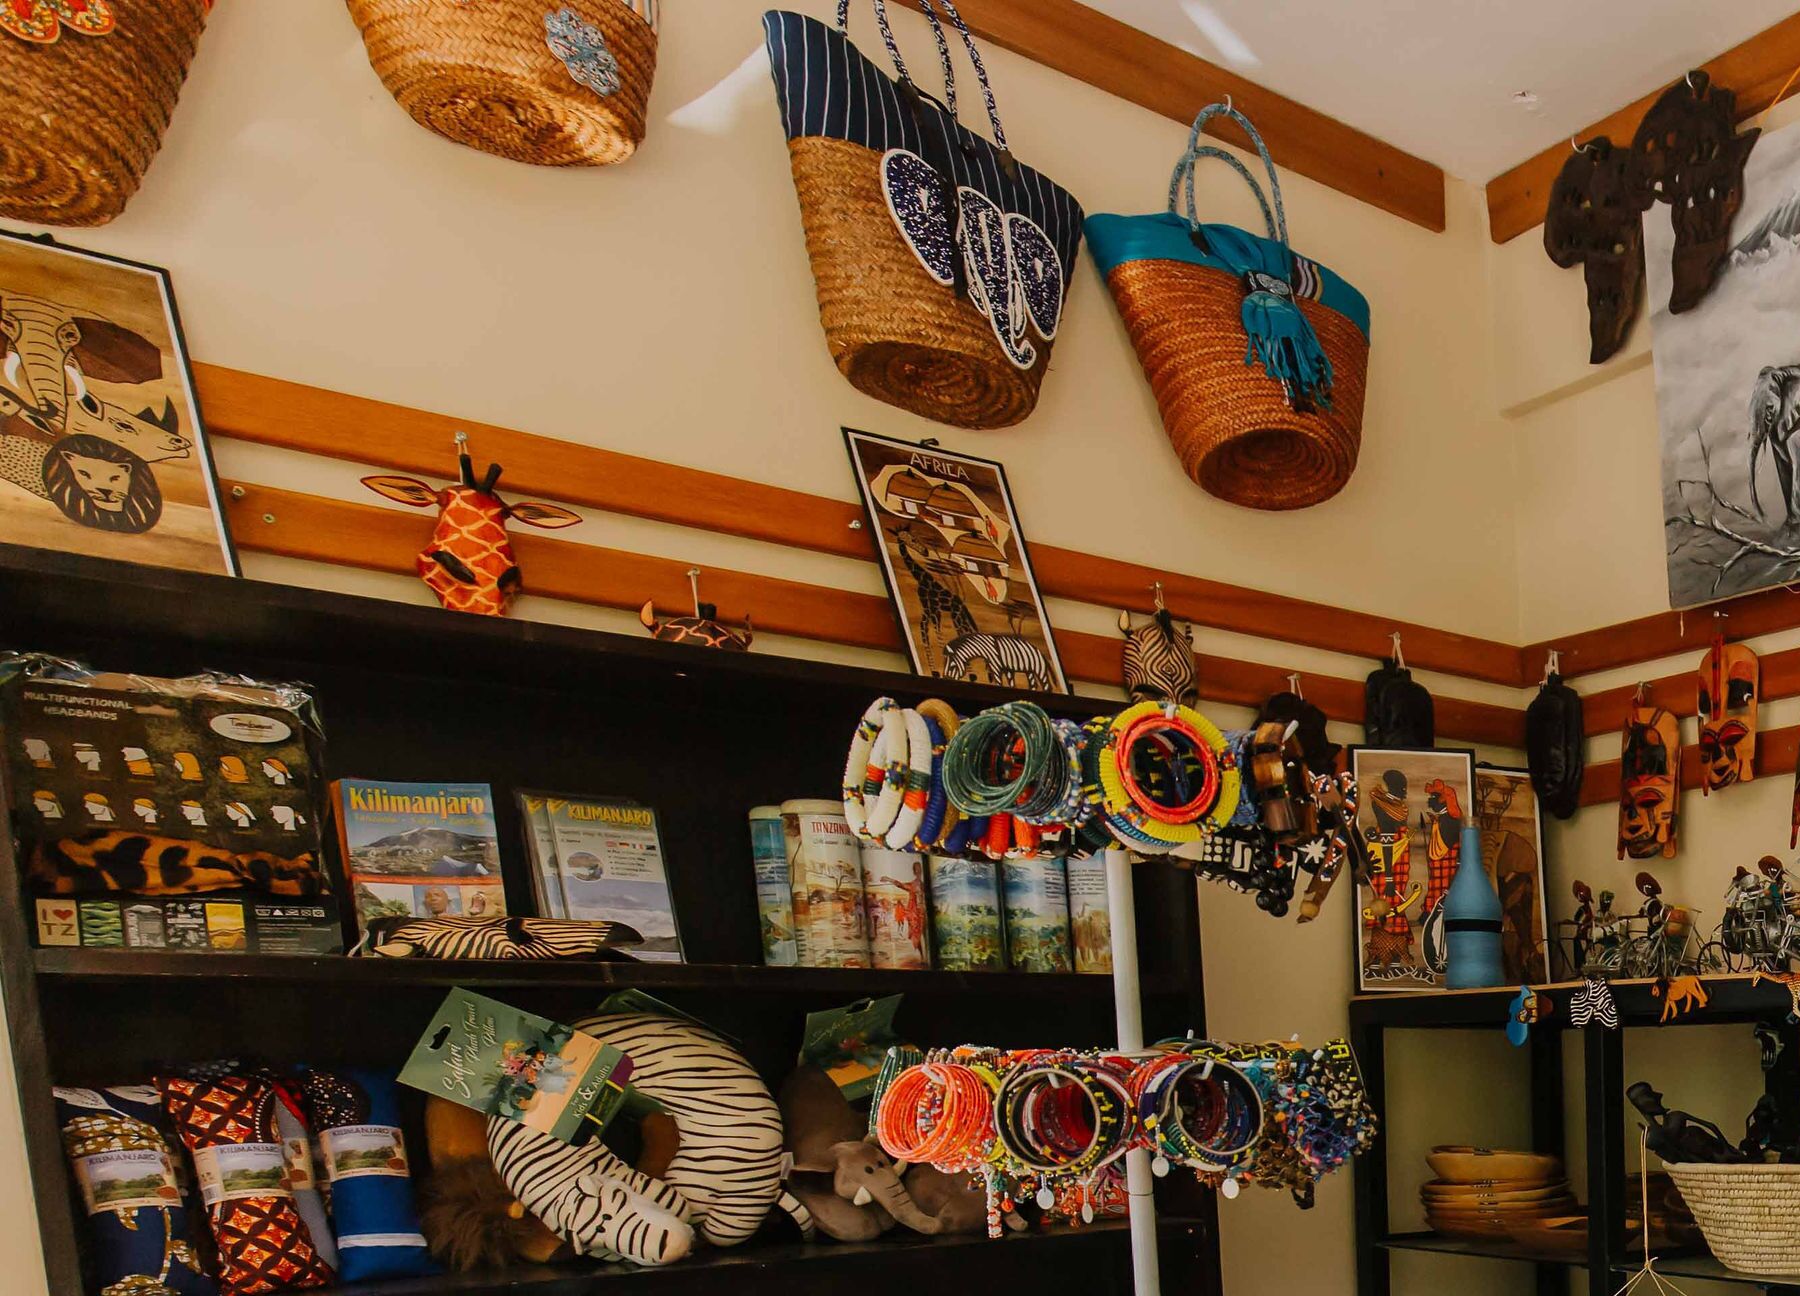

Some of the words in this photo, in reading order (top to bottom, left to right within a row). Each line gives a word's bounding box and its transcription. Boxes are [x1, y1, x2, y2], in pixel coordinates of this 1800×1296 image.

[910, 453, 970, 480] AFRICA
[23, 691, 133, 710] MULTIFUNCTIONAL
[43, 706, 118, 721] HEADBANDS
[350, 787, 486, 821] Kilimanjaro
[568, 804, 652, 827] KILIMANJARO
[442, 1042, 472, 1099] Safari
[592, 1064, 611, 1091] Adults
[577, 1084, 596, 1101] &
[572, 1101, 588, 1119] Kids
[327, 1127, 390, 1137] KILIMANJARO
[220, 1144, 281, 1155] KILIMANJARO
[88, 1153, 156, 1166] KILIMANJARO
